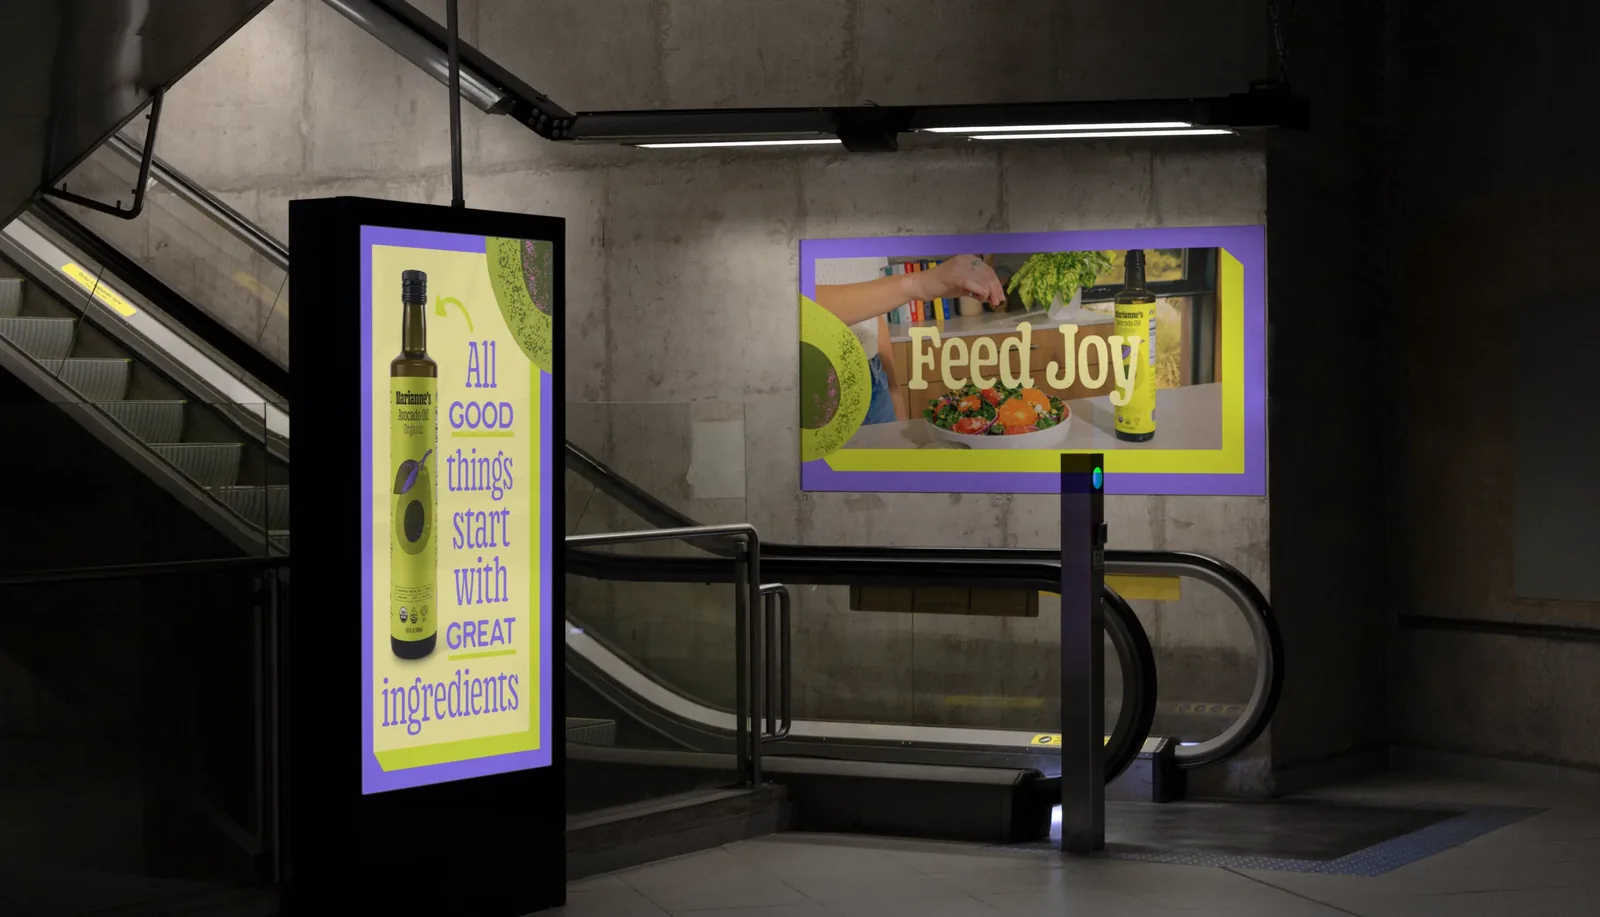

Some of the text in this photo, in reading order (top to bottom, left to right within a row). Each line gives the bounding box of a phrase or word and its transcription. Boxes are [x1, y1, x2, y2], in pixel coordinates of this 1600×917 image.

[465, 340, 497, 388] All
[908, 322, 1035, 390] Feed
[1045, 324, 1141, 406] Joy
[395, 391, 432, 405] Marianne's
[397, 408, 421, 421] Avocado
[449, 401, 514, 429] GOOD
[446, 448, 513, 501] things
[452, 507, 510, 550] start
[454, 556, 509, 606] with
[446, 617, 516, 650] GREAT
[381, 668, 519, 736] ingredients
